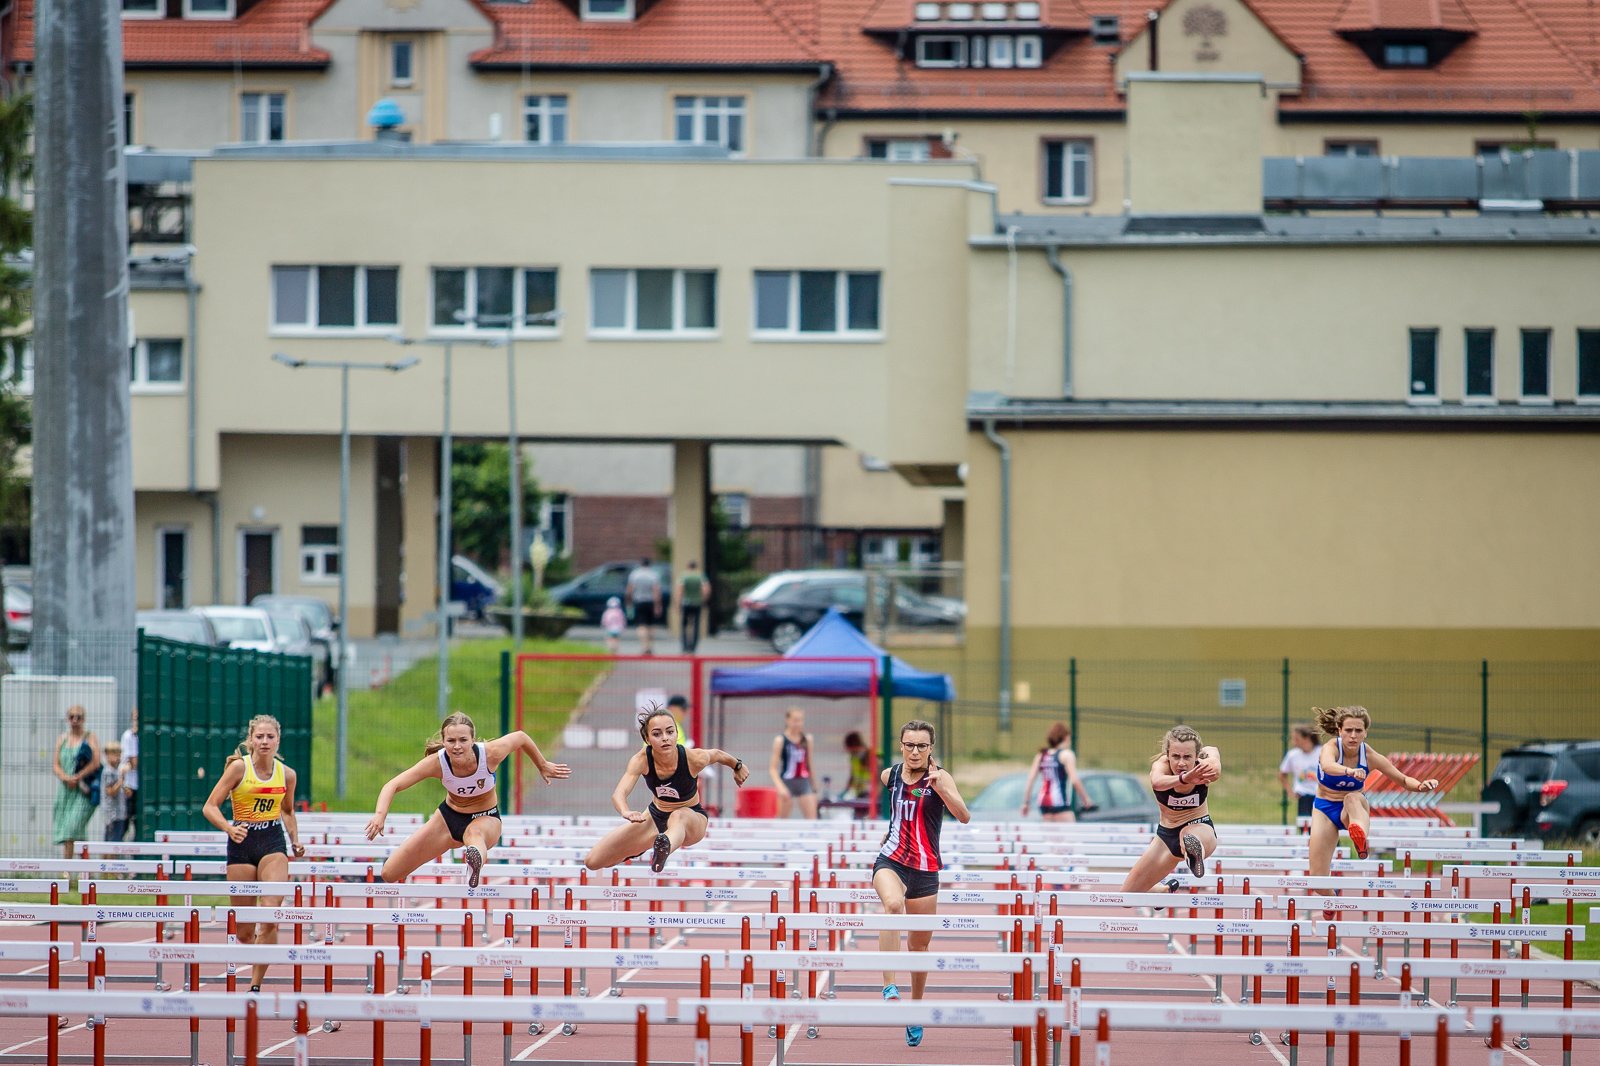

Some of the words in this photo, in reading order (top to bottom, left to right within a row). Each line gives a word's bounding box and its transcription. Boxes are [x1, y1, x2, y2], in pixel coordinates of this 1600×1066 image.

[457, 786, 476, 794] 87
[660, 788, 676, 796] 25
[252, 798, 275, 812] 760
[1172, 798, 1196, 806] 304
[896, 800, 916, 822] 717
[248, 821, 269, 830] PRO
